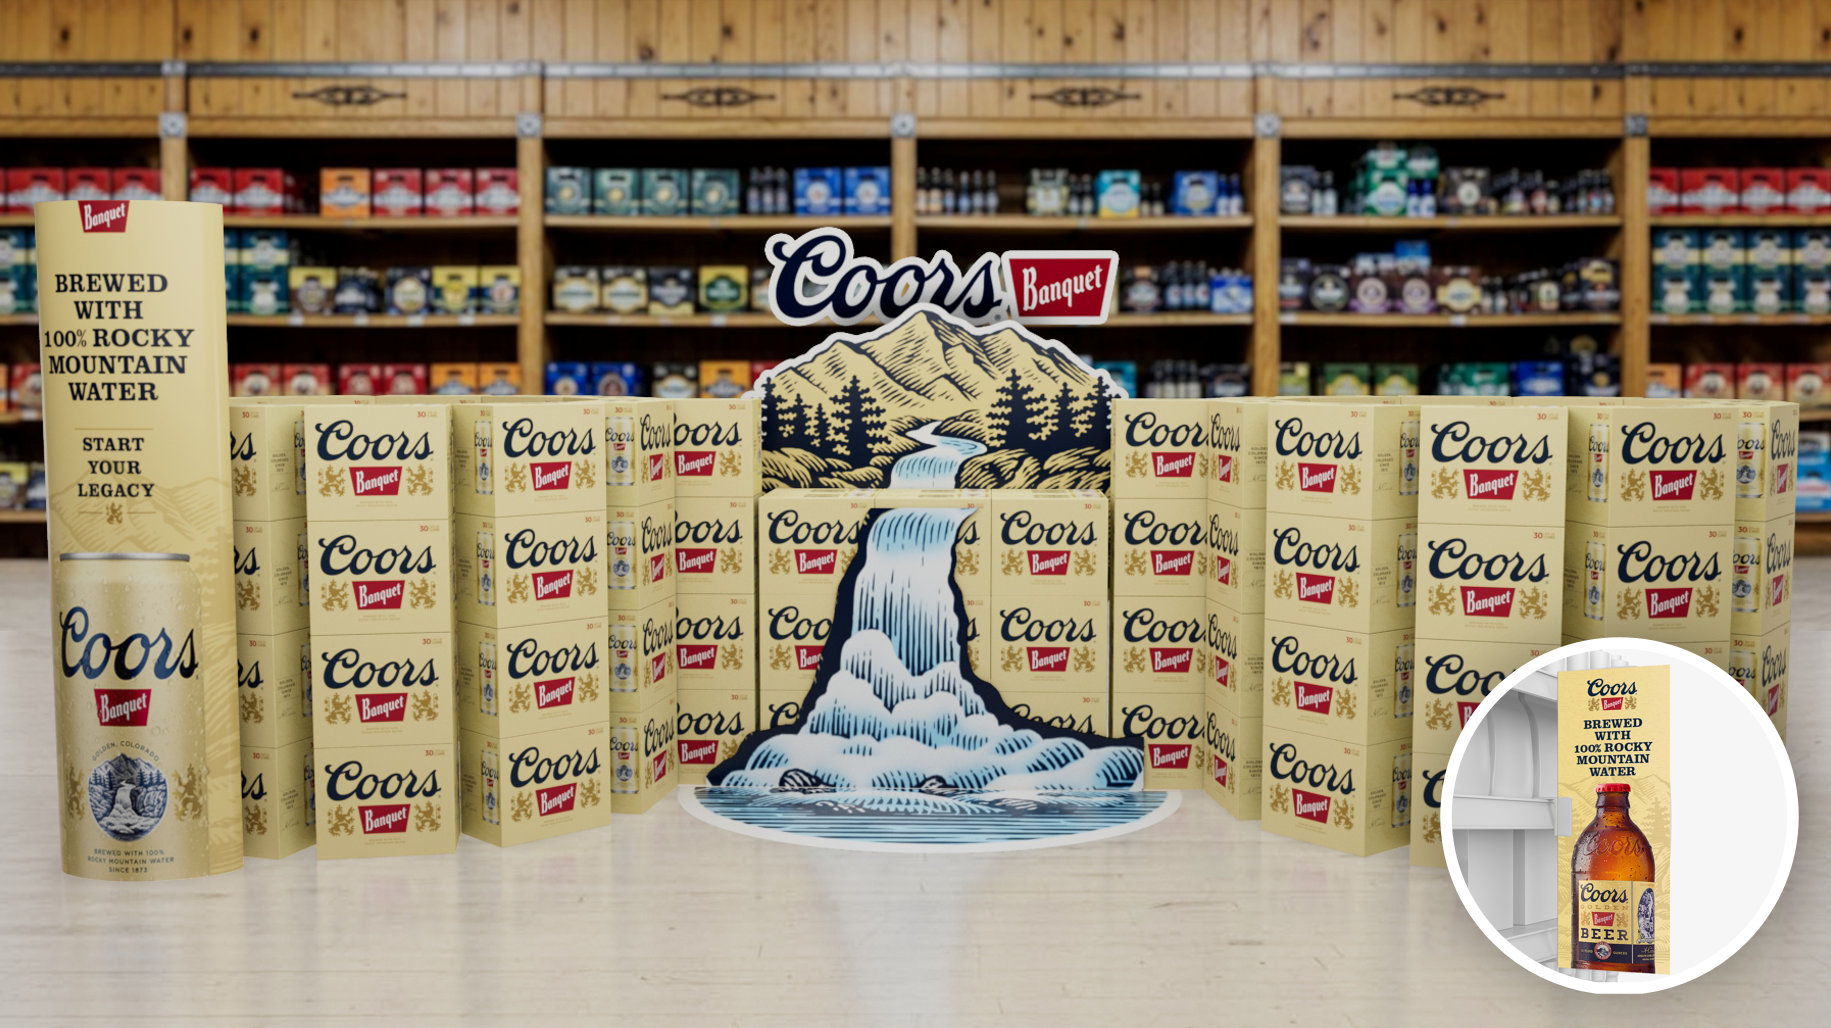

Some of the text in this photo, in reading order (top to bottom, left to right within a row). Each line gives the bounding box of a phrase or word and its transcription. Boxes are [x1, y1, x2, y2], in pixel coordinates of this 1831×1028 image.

[84, 203, 126, 231] Banquet
[55, 274, 168, 292] BREWED
[772, 234, 1102, 320] Coors Banquet
[74, 301, 143, 319] WITH
[44, 329, 194, 347] 100% ROCKY
[49, 356, 187, 374] MOUNTAIN
[68, 382, 159, 401] WATER
[83, 437, 144, 451] START
[315, 420, 433, 461] Coors
[503, 418, 596, 458] Coors
[605, 428, 635, 443] Coors
[640, 414, 671, 451] Coors
[674, 422, 742, 446] oors
[1211, 413, 1240, 452] Coors
[1275, 418, 1362, 459] Coors
[1431, 421, 1552, 464] Coors
[1621, 422, 1726, 464] Coors
[1772, 420, 1795, 460] Coors
[88, 461, 141, 474] YOUR
[678, 454, 714, 474] Banquet
[1157, 455, 1192, 475] Banquet
[356, 469, 398, 493] Banquet
[535, 464, 570, 490] Banquet
[1302, 467, 1336, 490] Banquet
[1470, 473, 1514, 496] Banquet
[1655, 474, 1693, 498] Banquet
[78, 484, 155, 497] LEGACY
[607, 532, 636, 547] Coors
[642, 517, 672, 554] Coors
[675, 519, 742, 543] oors
[1000, 511, 1097, 545] Coors
[1210, 514, 1238, 556] Coors
[318, 535, 436, 575] Coors
[505, 529, 597, 569] Coors
[679, 551, 713, 570] Banquet
[1273, 528, 1360, 572] Coors
[1428, 539, 1549, 582] Coors
[1767, 533, 1790, 574] Coors
[799, 552, 834, 572] Banquet
[1032, 553, 1068, 575] Banquet
[1156, 553, 1193, 573] Banquet
[1617, 541, 1721, 583] Coors
[359, 583, 402, 609] Banquet
[537, 571, 572, 599] Banquet
[1300, 576, 1334, 598] Banquet
[1467, 590, 1511, 613] Banquet
[1651, 591, 1688, 615] Banquet
[676, 616, 743, 640] oors
[768, 606, 832, 640] Coo
[1000, 607, 1096, 642] Coors
[59, 606, 199, 680] Coors
[608, 635, 637, 650] Coors
[643, 618, 673, 656] Coors
[1208, 614, 1237, 659] Coors
[1734, 639, 1743, 647] 30
[507, 639, 599, 679] Coors
[681, 647, 714, 667] Banquet
[1032, 650, 1066, 669] Banquet
[1155, 651, 1189, 670] Banquet
[1272, 636, 1357, 684] Coors
[1530, 649, 1540, 657] 30
[322, 649, 439, 689] Coors
[1762, 646, 1786, 687] Coors
[538, 679, 574, 708] Banquet
[1298, 684, 1331, 714] Banquet
[1587, 679, 1637, 697] Coors
[100, 692, 147, 724] Banquet
[362, 696, 403, 722] Banquet
[1603, 699, 1622, 710] Banquet
[677, 711, 744, 735] oors
[1583, 718, 1643, 729] BREWED
[610, 737, 638, 751] Coors
[644, 719, 674, 759] Coors
[1207, 712, 1235, 763] Coors
[1574, 741, 1652, 753] 100% ROCKY
[1594, 730, 1631, 741] WITH
[121, 741, 159, 761] COLORADO
[682, 743, 715, 762] Banquet
[1154, 747, 1188, 766] Banquet
[1576, 753, 1650, 765] MOUNTAIN
[509, 747, 600, 788] Coors
[1270, 743, 1355, 795] Coors
[1589, 766, 1636, 777] WATER
[325, 761, 441, 801] Coors
[539, 785, 575, 815] Banquet
[1295, 792, 1329, 823] Banquet
[365, 807, 408, 833] Banquet
[1580, 883, 1628, 903] Coors
[1594, 913, 1613, 924] Banquet
[1581, 928, 1628, 940] BEER
